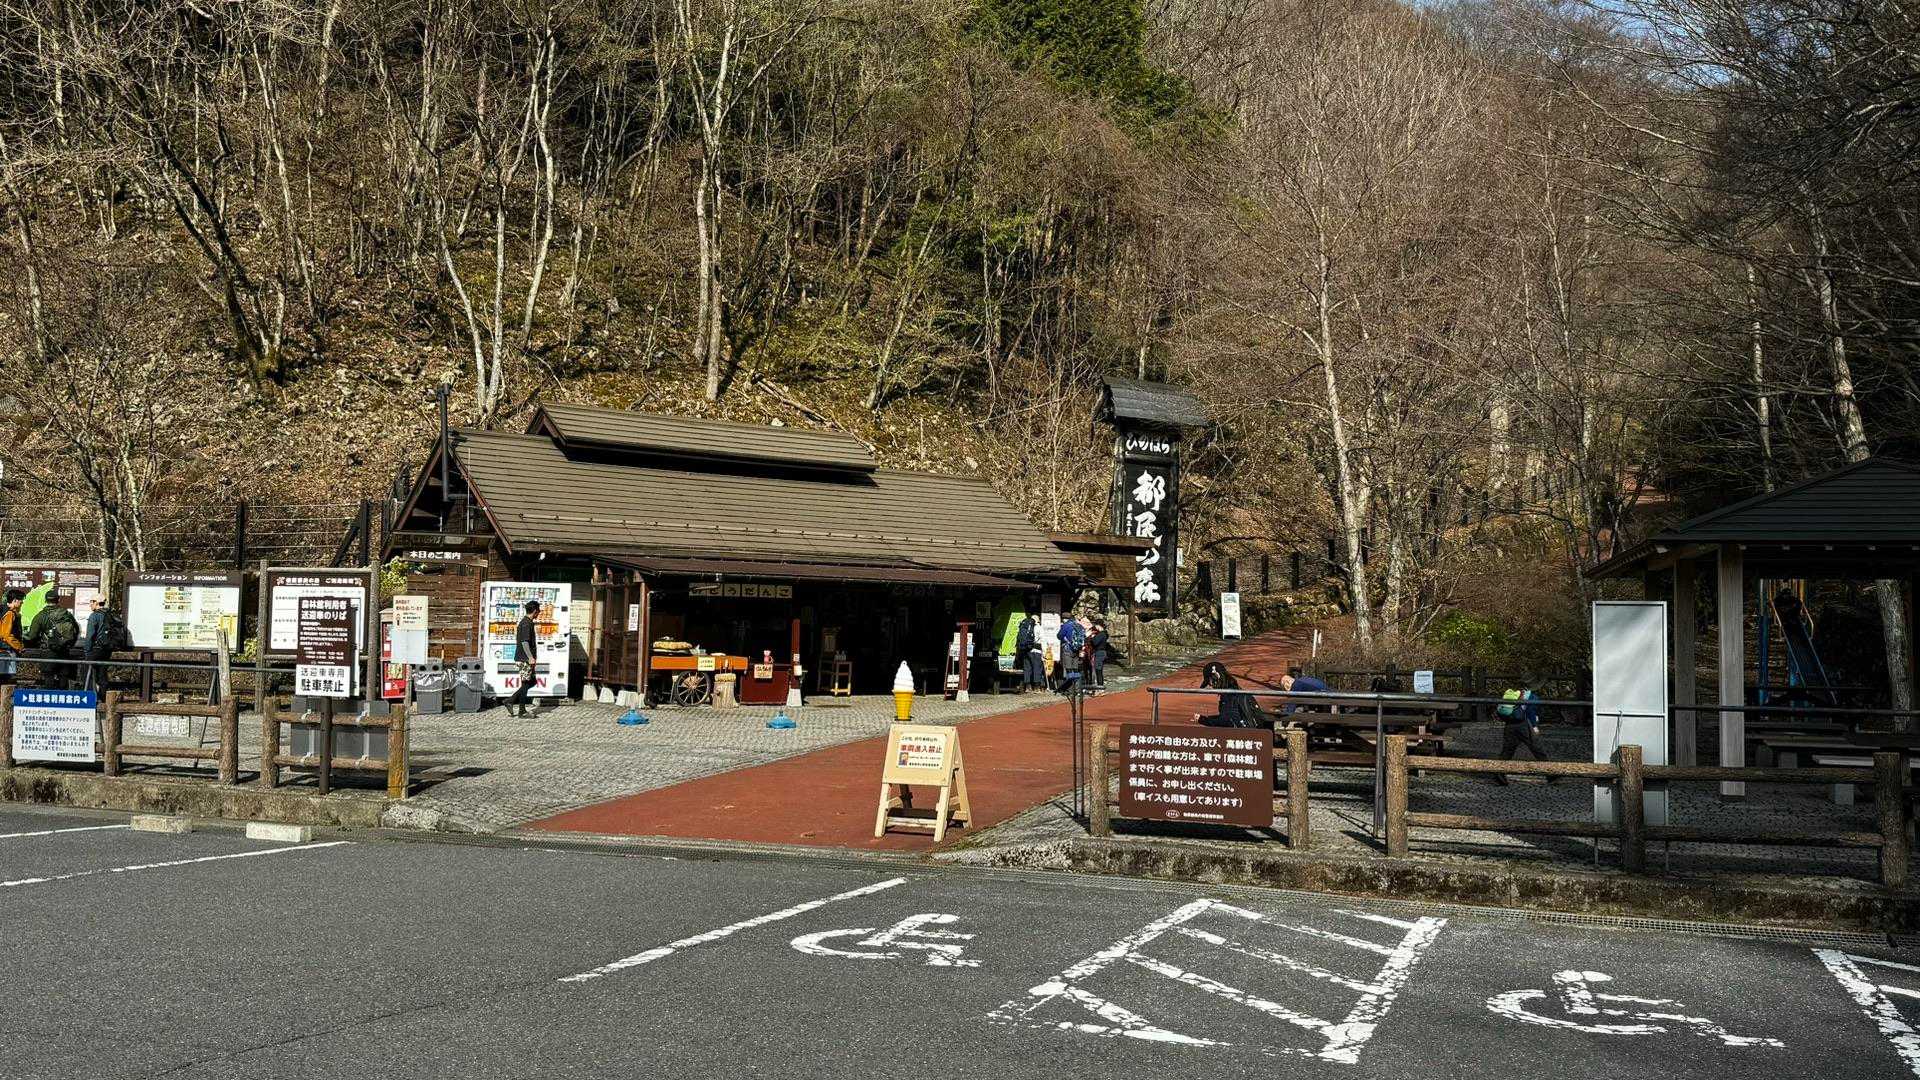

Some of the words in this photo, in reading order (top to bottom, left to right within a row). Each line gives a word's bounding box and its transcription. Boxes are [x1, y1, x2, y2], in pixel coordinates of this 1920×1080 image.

[1126, 436, 1170, 454] ひのはら
[409, 551, 461, 560] 本日のご案内
[301, 679, 344, 692] 駐車禁止
[504, 677, 547, 688] KIN
[1129, 735, 1262, 749] 身体の不自由な方及び、高齢者で
[1129, 750, 1258, 765] 歩行が困難な方は、車で「森林館」
[1129, 764, 1263, 780] まで行く事が出来ますので駐車場
[1129, 777, 1235, 792] 係員に、お申し出ください。
[1133, 792, 1243, 807] （車イスも用意してあります）
